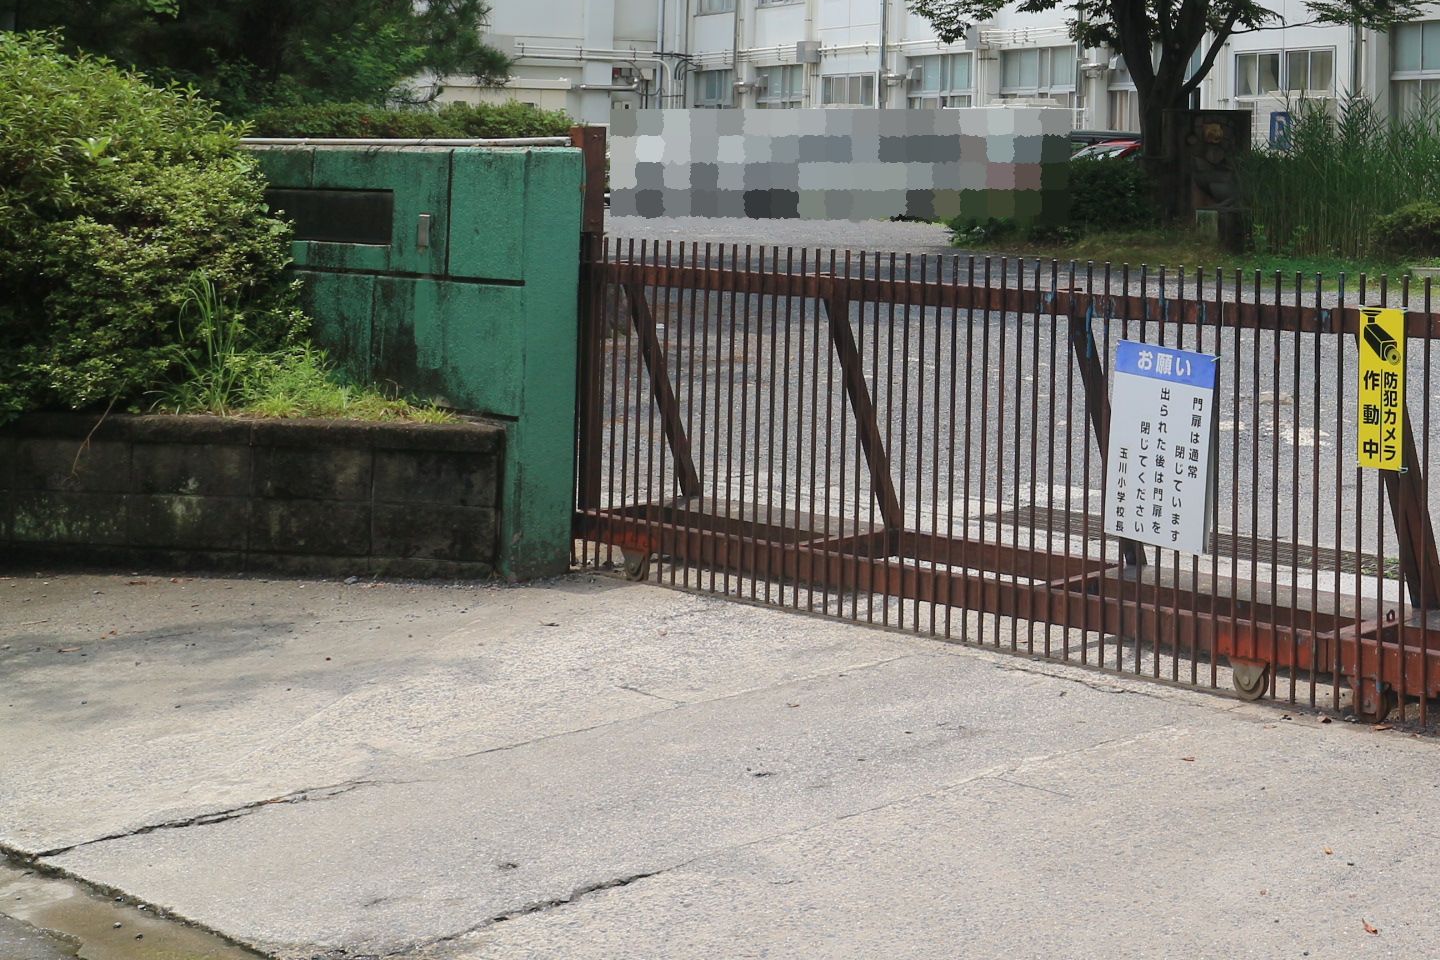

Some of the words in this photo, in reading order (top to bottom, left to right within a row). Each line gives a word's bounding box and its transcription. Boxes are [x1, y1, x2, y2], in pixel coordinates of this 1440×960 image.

[1137, 350, 1192, 376] お願い
[1187, 397, 1203, 479] 門扉は通常
[1363, 370, 1380, 459] 作動中
[1383, 371, 1399, 462] 防犯カメラ
[1115, 447, 1129, 533] 玉川小学校長
[1134, 421, 1151, 533] 閉じてください
[1152, 387, 1170, 534] 出られた後は門扉を
[1171, 445, 1186, 542] 閉じています
